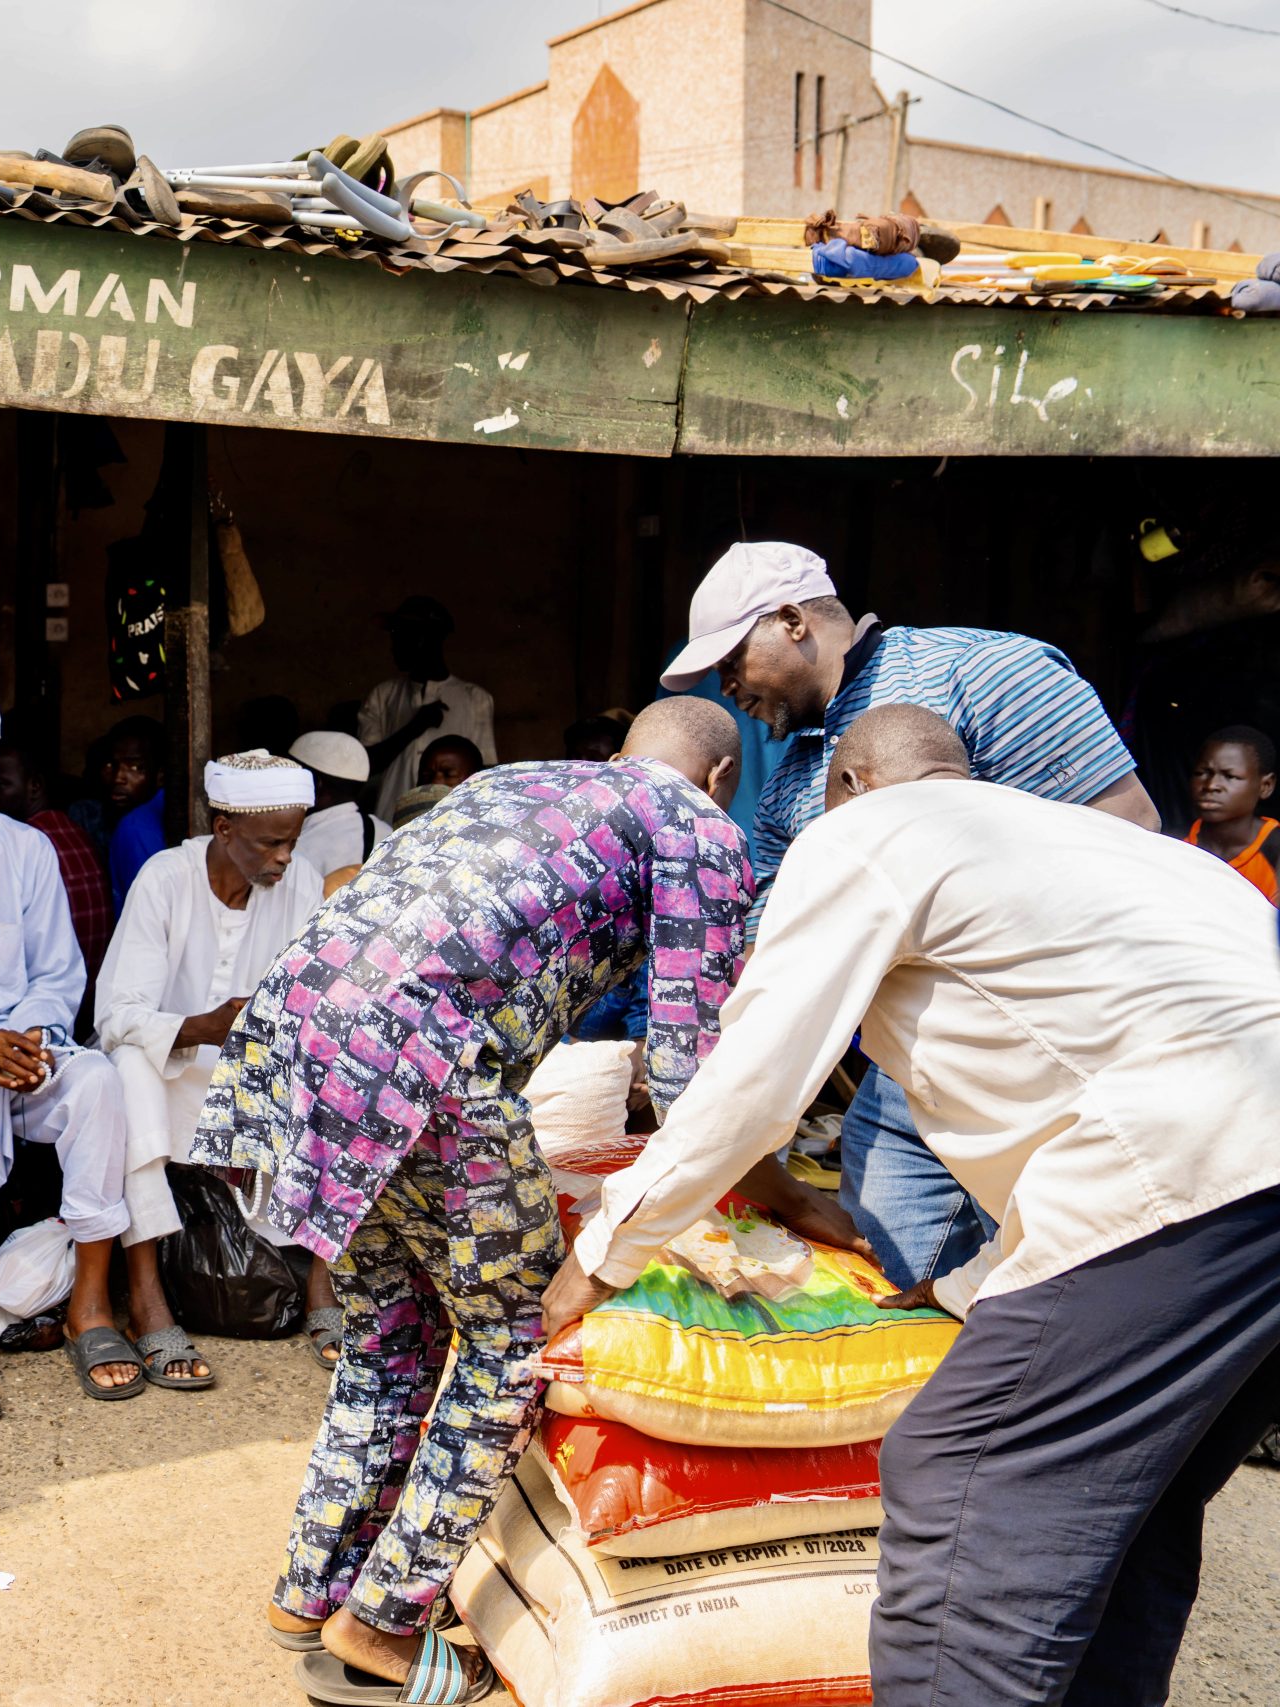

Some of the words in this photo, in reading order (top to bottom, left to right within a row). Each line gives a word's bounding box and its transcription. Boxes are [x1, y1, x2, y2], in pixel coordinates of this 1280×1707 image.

[189, 344, 391, 426] GAYA
[664, 1557, 705, 1575] DATE
[708, 1551, 727, 1567] OF
[733, 1543, 789, 1563] EXPIRY
[803, 1539, 866, 1555] 07/2028
[844, 1583, 871, 1595] LOT
[599, 1607, 668, 1635] PRODUCT
[673, 1602, 694, 1617] OF
[698, 1596, 740, 1613] INDIA
